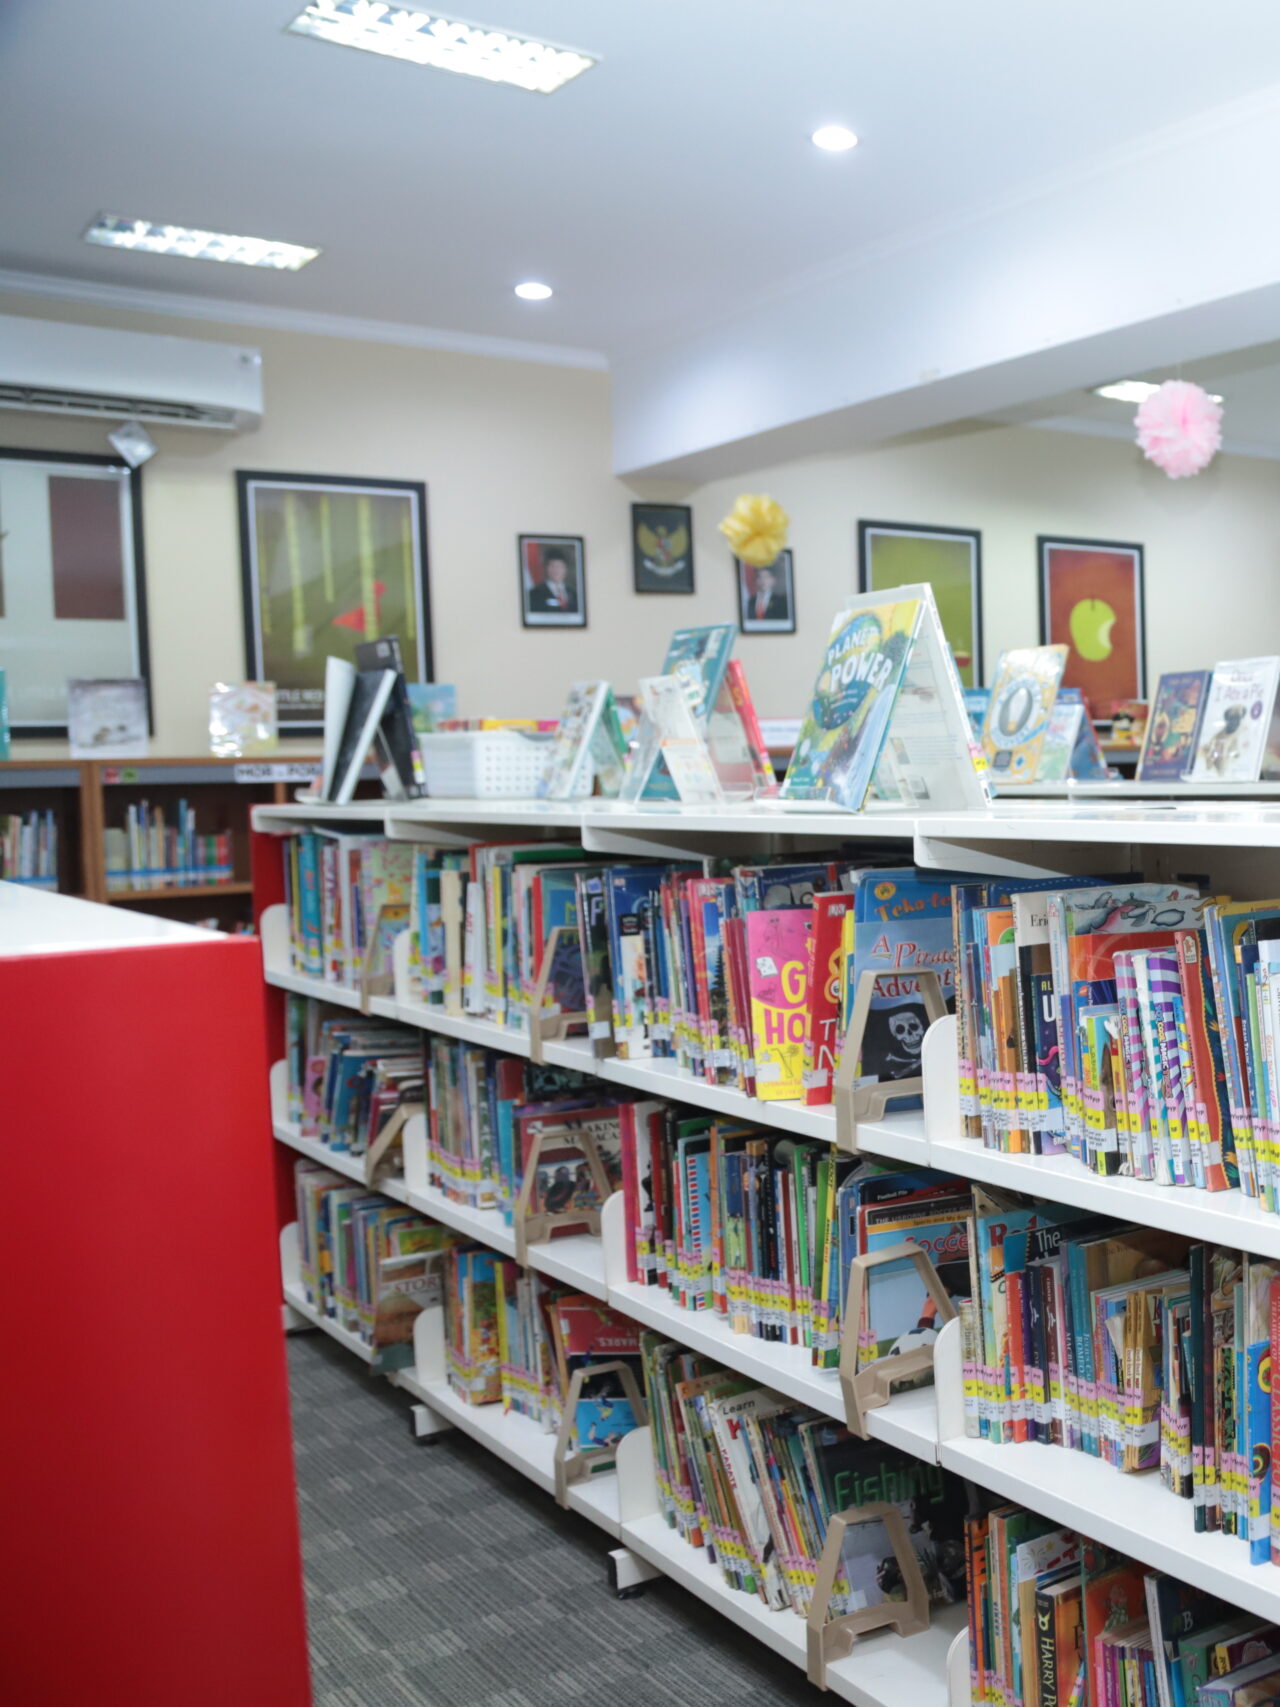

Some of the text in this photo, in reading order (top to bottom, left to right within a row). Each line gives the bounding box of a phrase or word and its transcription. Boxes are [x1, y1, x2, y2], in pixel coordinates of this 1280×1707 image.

[830, 652, 893, 692] POWER
[872, 935, 891, 954] A
[1036, 1228, 1061, 1248] The
[1076, 1336, 1084, 1373] ROMEO
[723, 1400, 755, 1415] Learn
[720, 1449, 738, 1490] KARATE
[1041, 1637, 1055, 1691] HARRY
